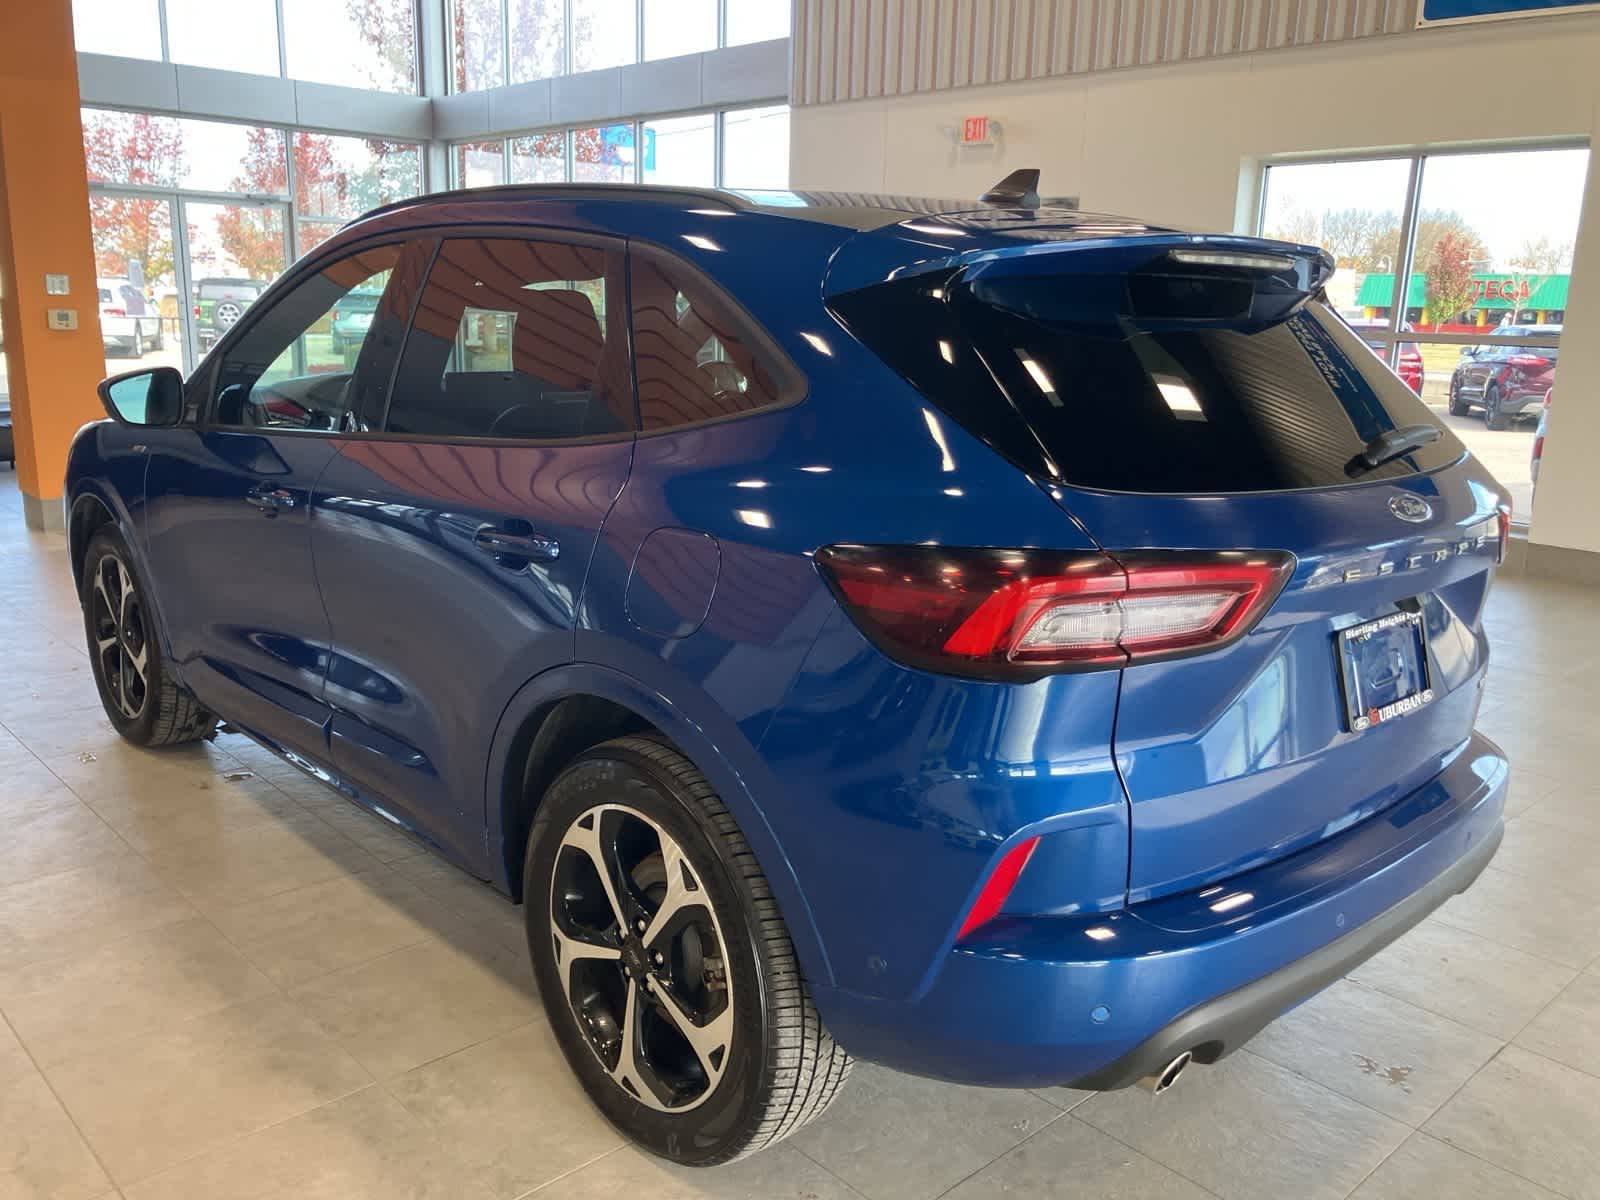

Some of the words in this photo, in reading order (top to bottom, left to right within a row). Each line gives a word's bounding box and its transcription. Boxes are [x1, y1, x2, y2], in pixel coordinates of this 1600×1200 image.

[964, 117, 989, 142] EXIT
[1345, 535, 1486, 583] ESCAPE
[1368, 694, 1422, 726] SUBURBAN
